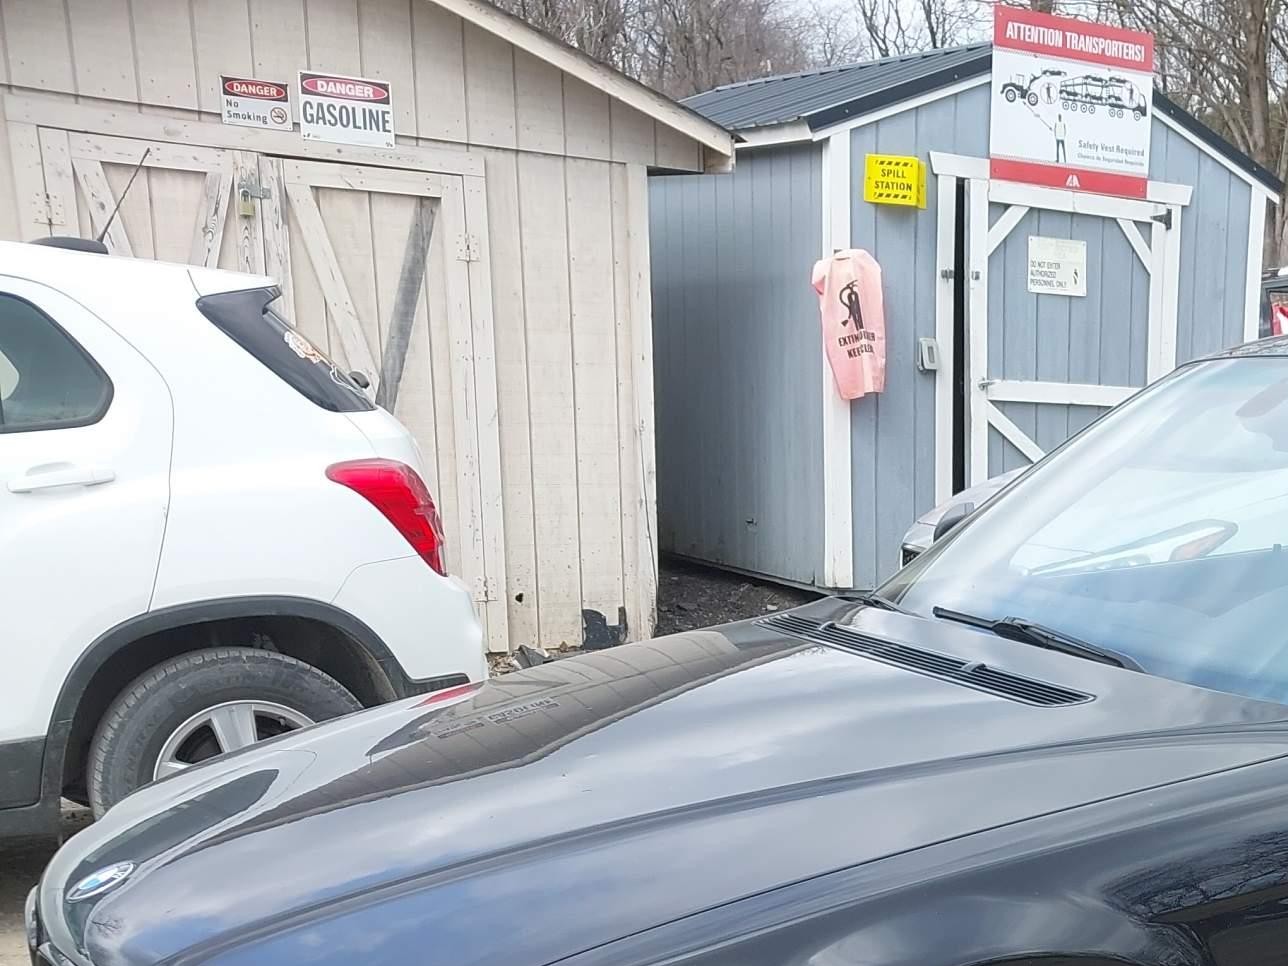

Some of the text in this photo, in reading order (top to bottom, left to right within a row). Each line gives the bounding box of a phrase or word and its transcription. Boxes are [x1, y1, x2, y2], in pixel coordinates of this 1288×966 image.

[1006, 22, 1144, 62] ATTENTION TRANSPORTERS!
[233, 82, 277, 97] DANGER
[317, 80, 374, 98] DANGER
[226, 99, 239, 108] No
[226, 111, 268, 125] Smoking
[303, 101, 391, 133] GASOLINE
[1078, 140, 1144, 157] Safety Vest Required
[881, 168, 906, 179] SPILL
[874, 180, 912, 192] STATION
